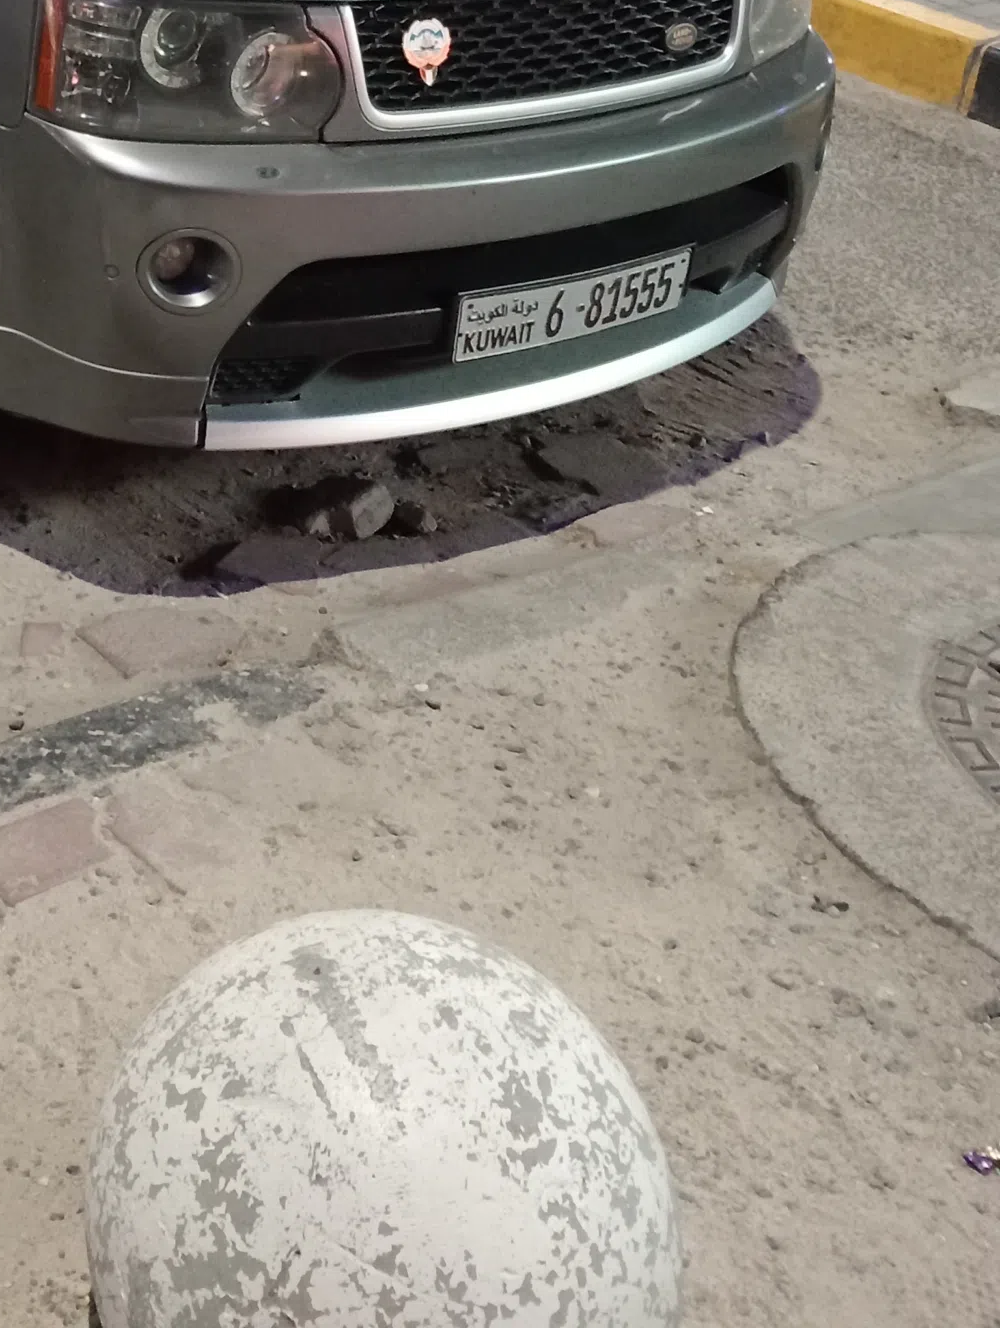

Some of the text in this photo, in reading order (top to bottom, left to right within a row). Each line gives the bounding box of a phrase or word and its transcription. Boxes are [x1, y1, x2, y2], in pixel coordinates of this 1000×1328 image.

[467, 298, 539, 324] دولة الكويت
[463, 321, 535, 354] KUWAIT
